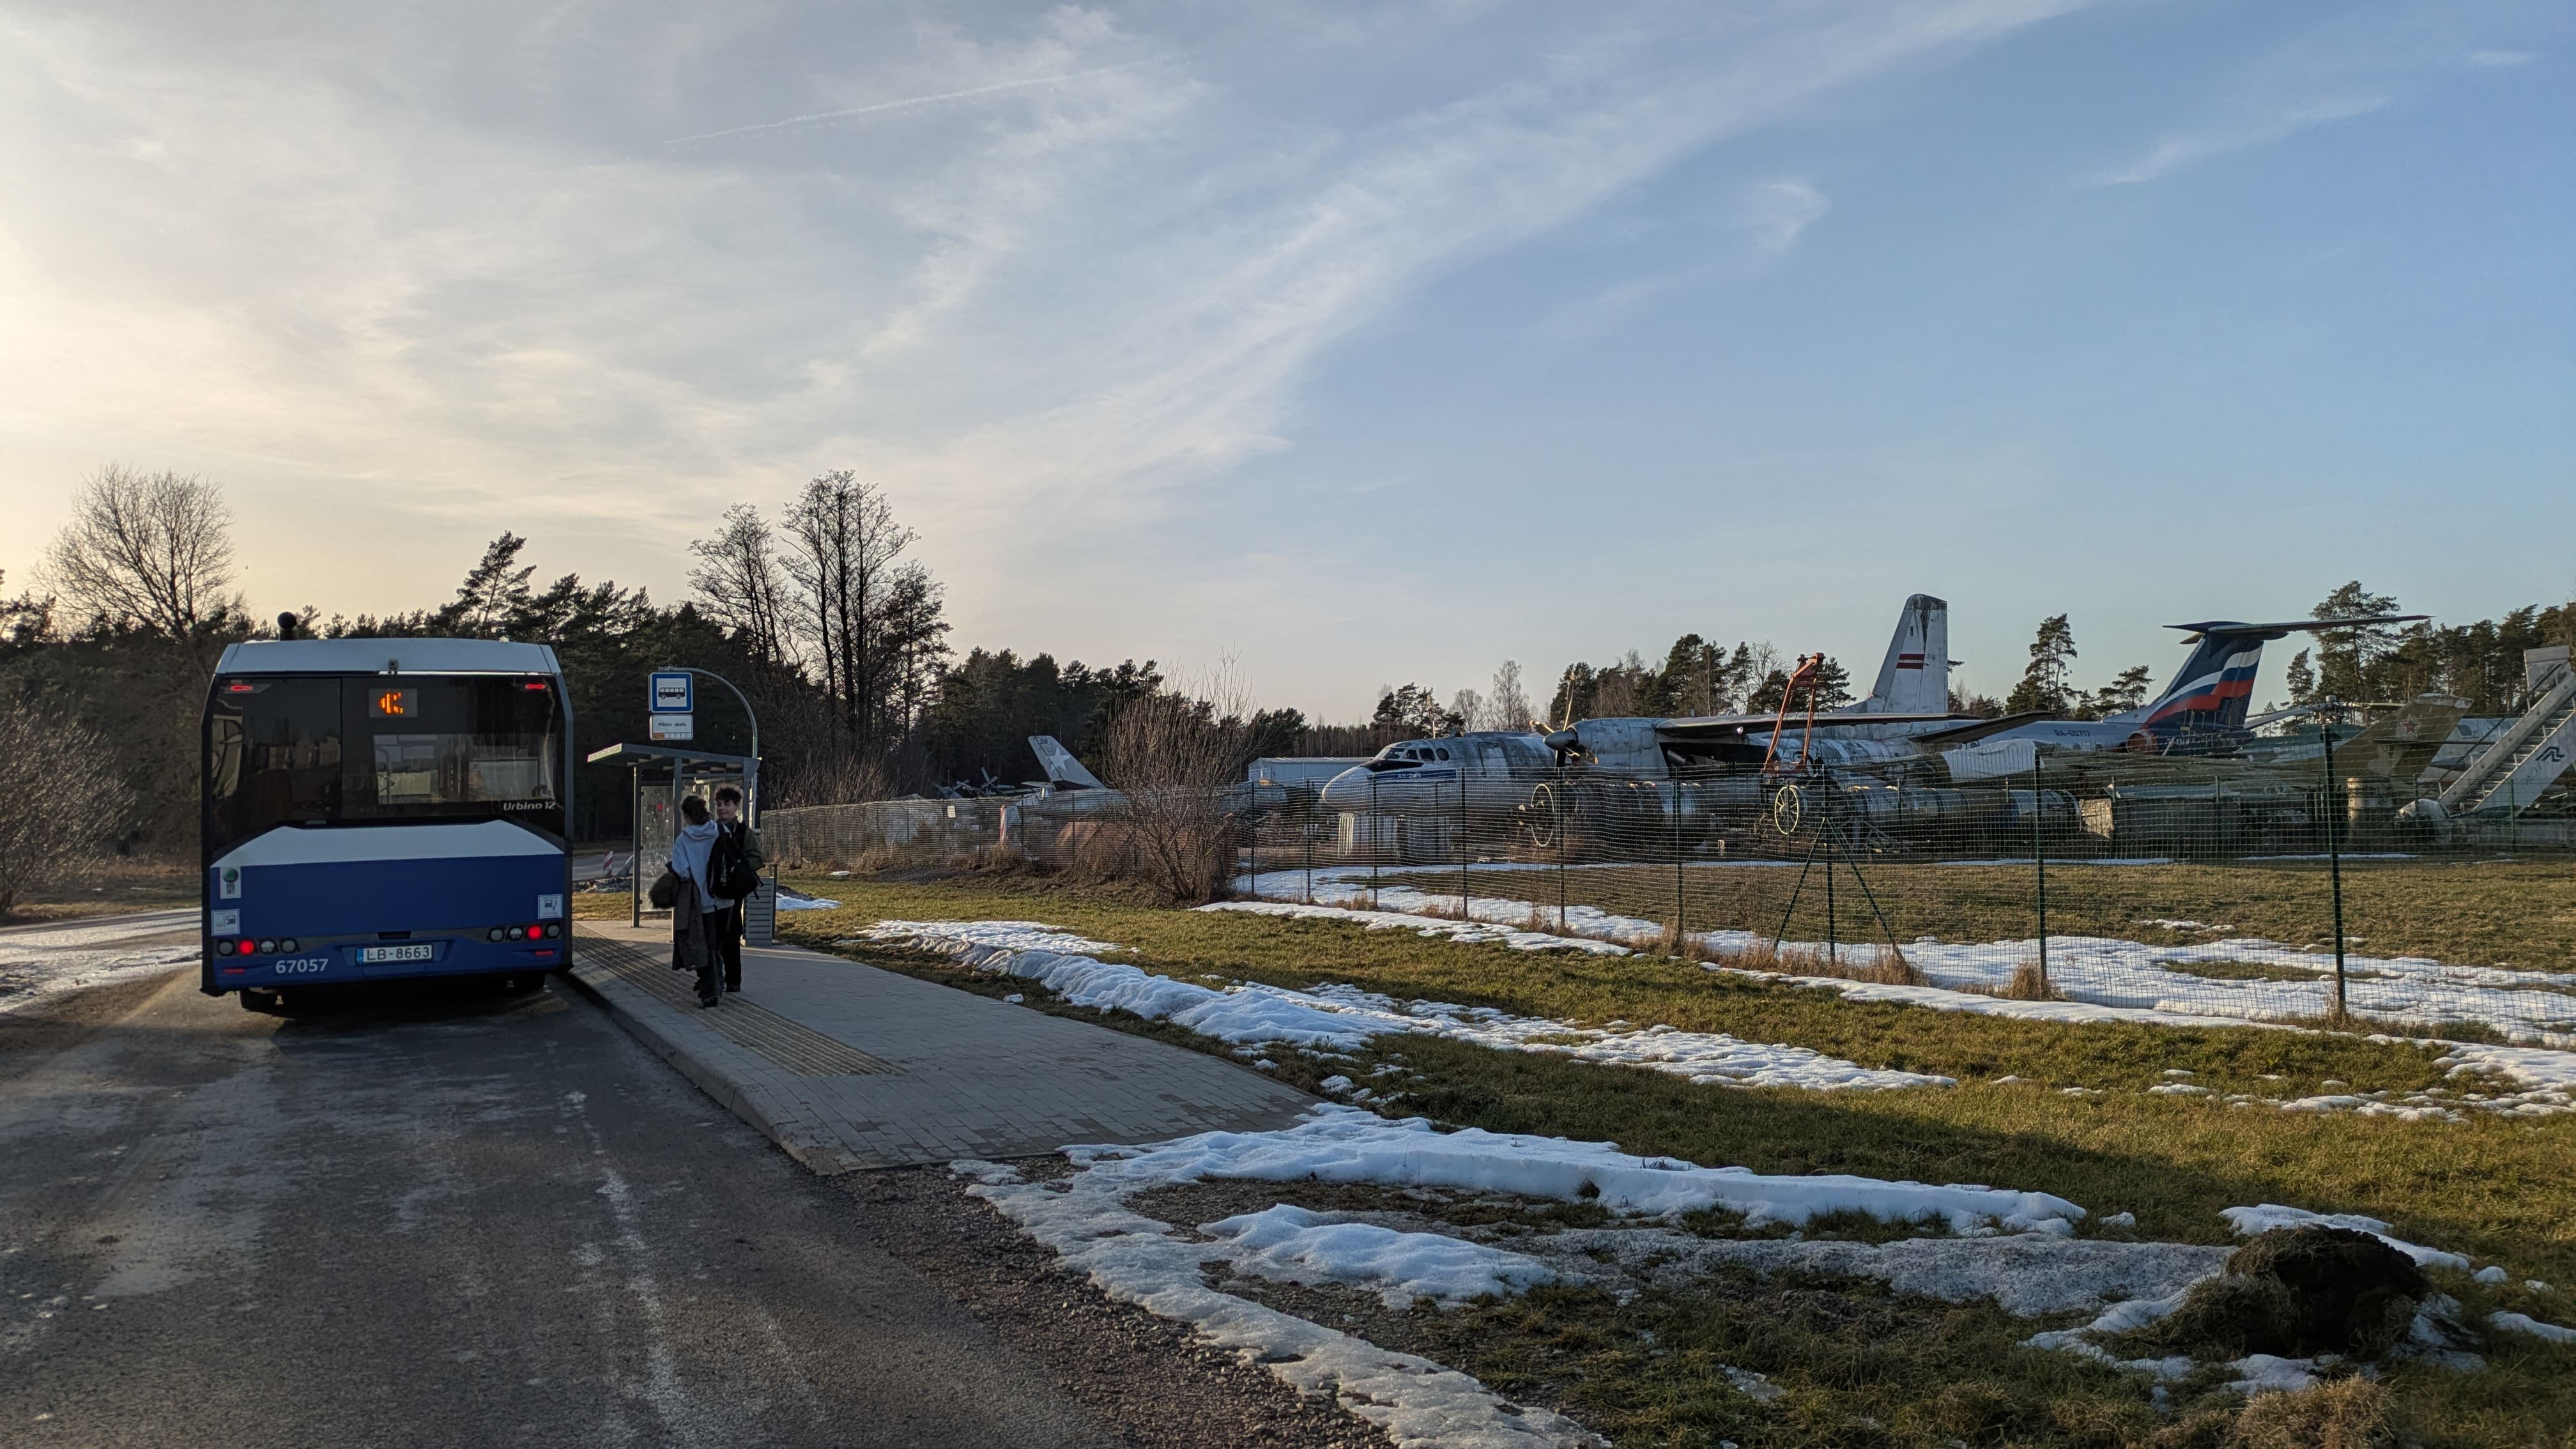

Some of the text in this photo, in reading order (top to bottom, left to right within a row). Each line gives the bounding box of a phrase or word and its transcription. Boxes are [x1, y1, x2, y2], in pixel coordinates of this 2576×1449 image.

[503, 801, 556, 811] Urbino 12
[366, 946, 431, 961] LB-8663
[275, 958, 329, 974] 67057
